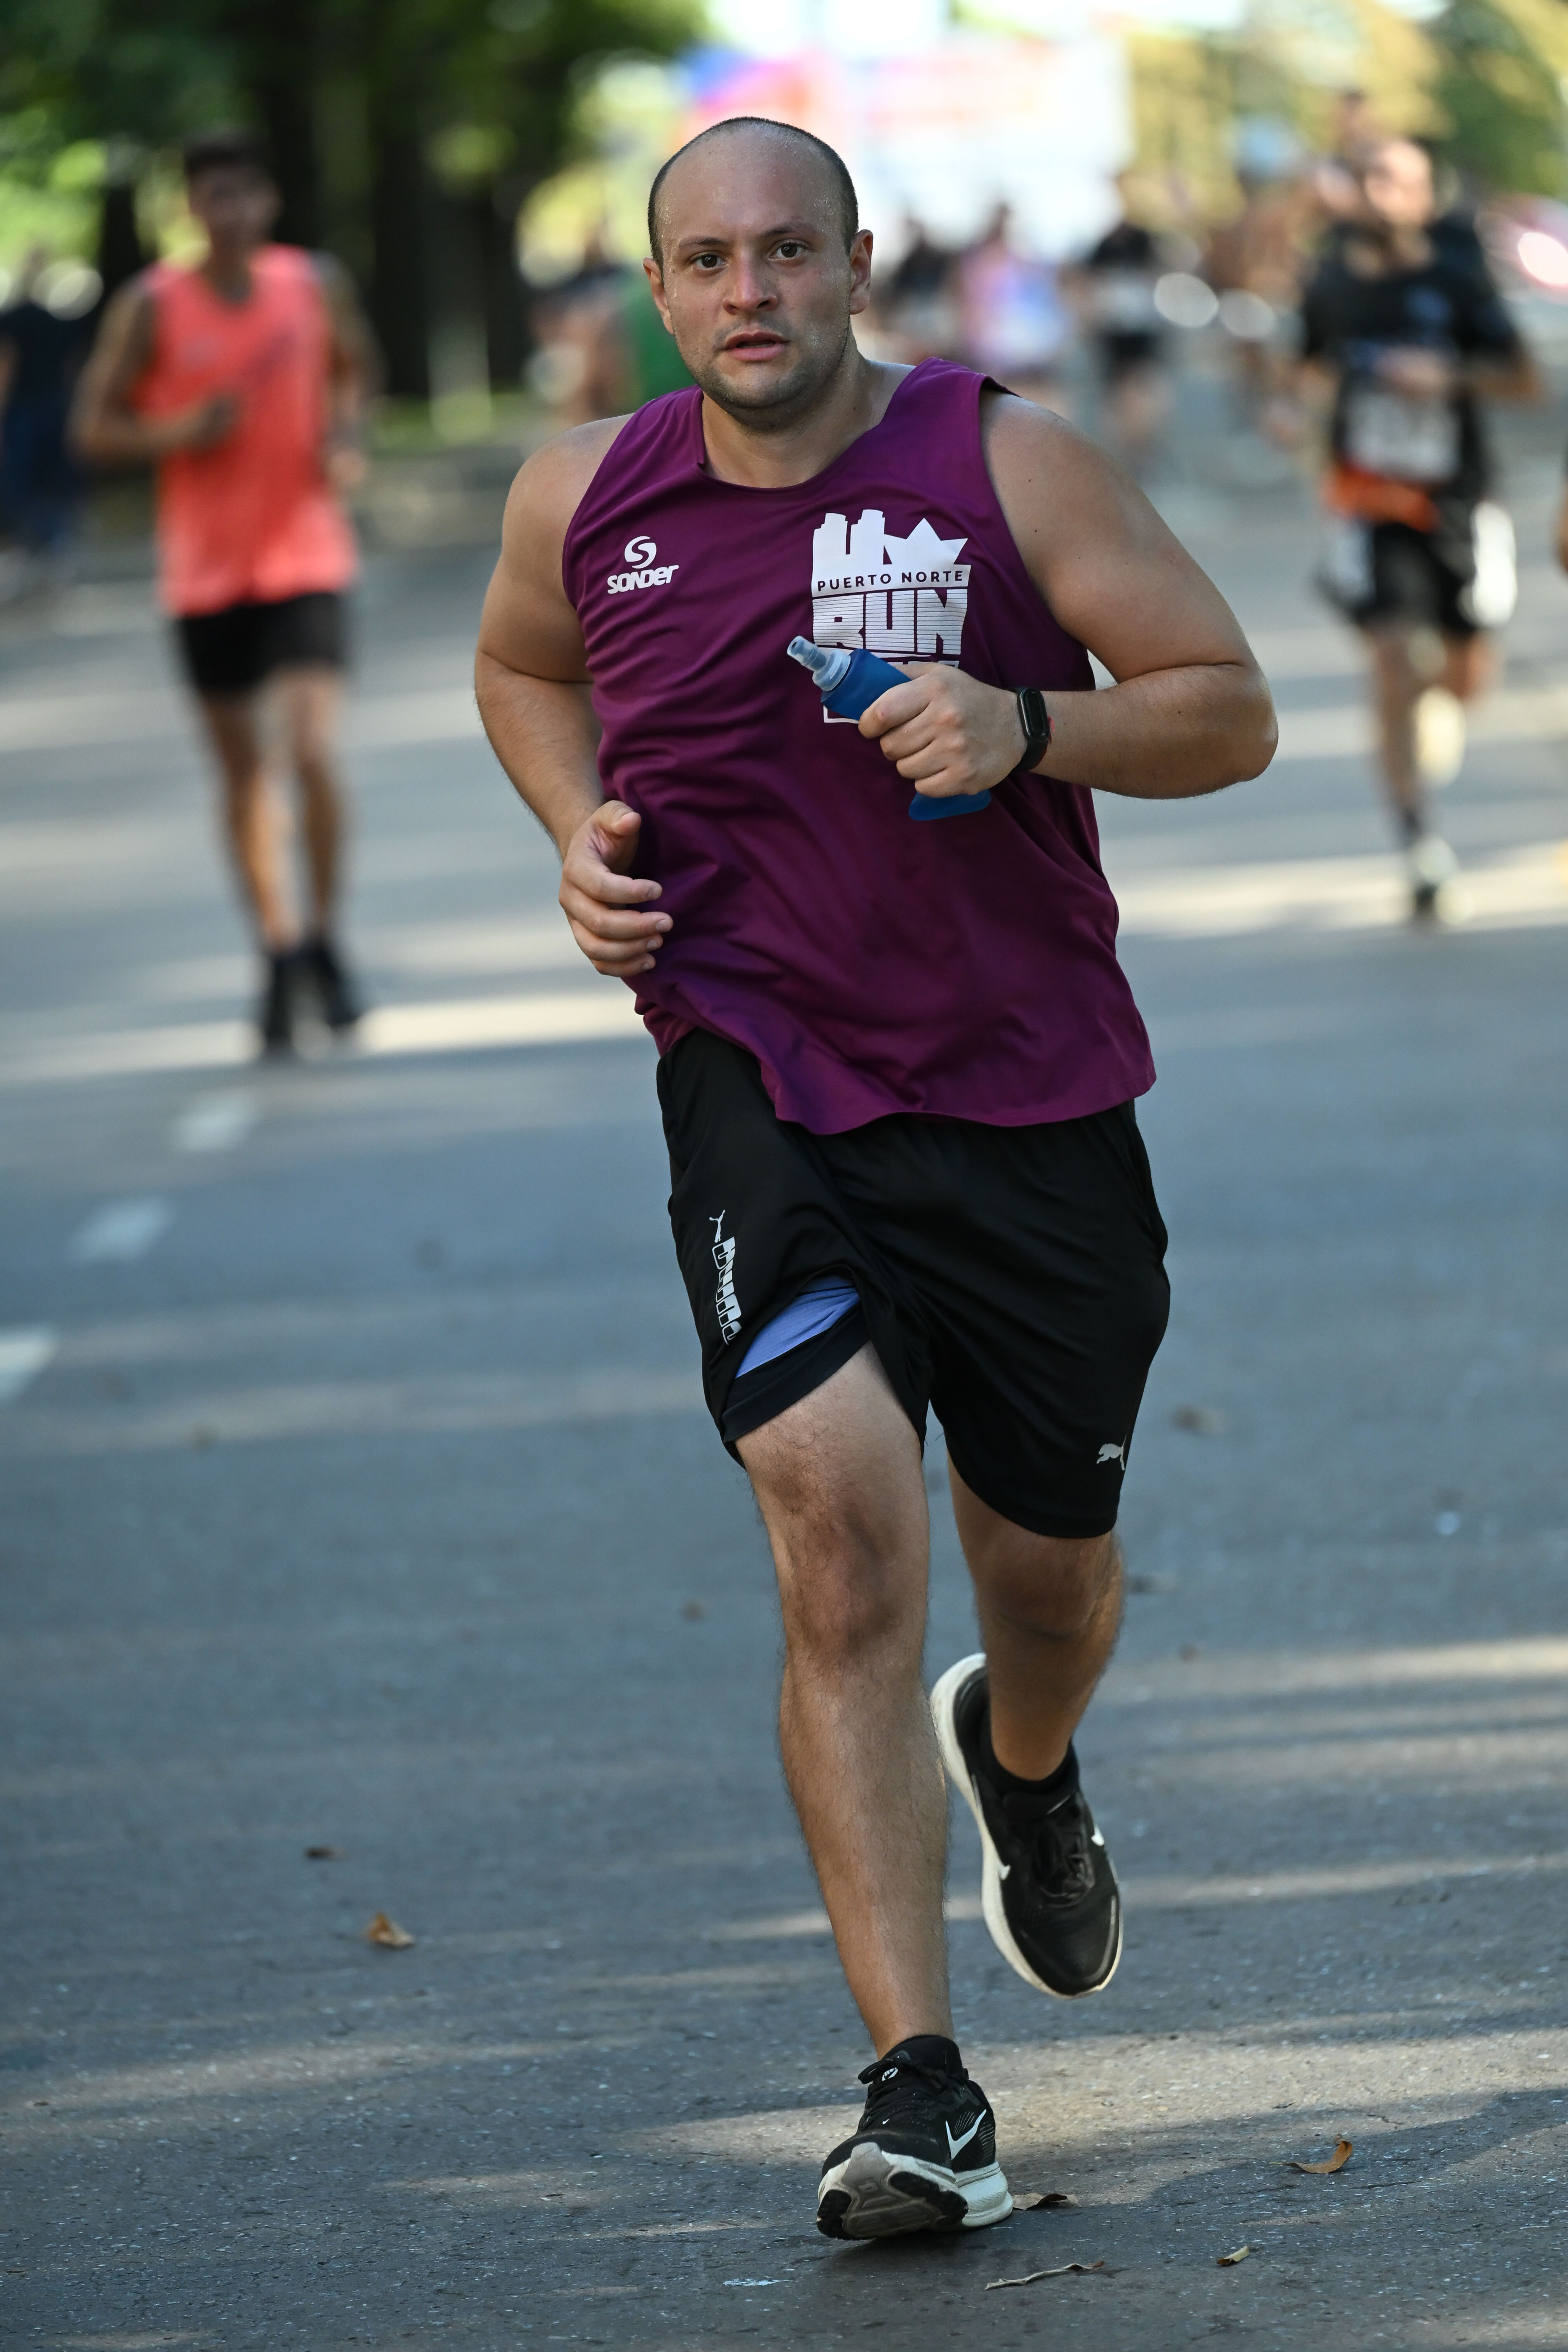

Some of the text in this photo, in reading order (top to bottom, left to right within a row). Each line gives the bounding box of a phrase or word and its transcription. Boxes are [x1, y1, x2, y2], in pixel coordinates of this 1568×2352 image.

[817, 570, 963, 592] PUERTO NORTE
[812, 589, 968, 655] RUN
